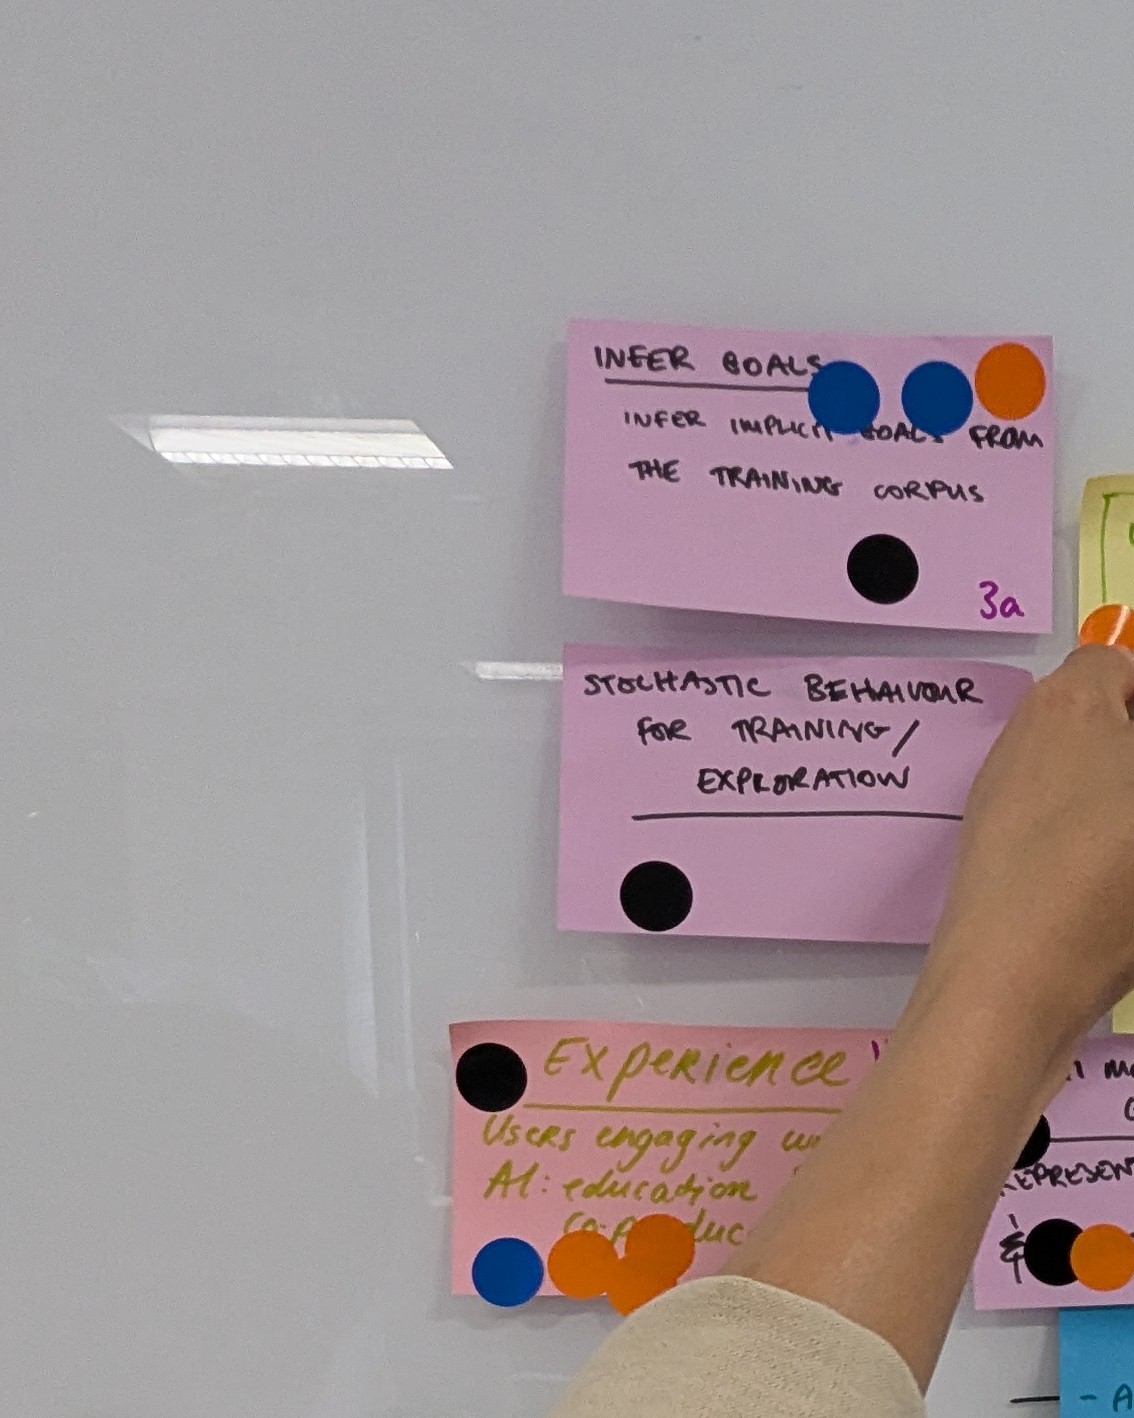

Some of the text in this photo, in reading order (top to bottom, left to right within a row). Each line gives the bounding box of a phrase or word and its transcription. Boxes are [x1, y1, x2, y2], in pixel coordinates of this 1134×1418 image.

[594, 345, 695, 371] INFER
[625, 410, 707, 428] INFER
[969, 425, 1044, 449] FROM
[629, 459, 984, 503] THE TRAINING CORPUS
[979, 580, 1024, 620] 3a
[584, 671, 771, 698] STOCHASTIC
[697, 767, 910, 794] EXPLORATION
[544, 1036, 849, 1101] Experience
[596, 1122, 757, 1174] engaging
[564, 1169, 758, 1206] education
